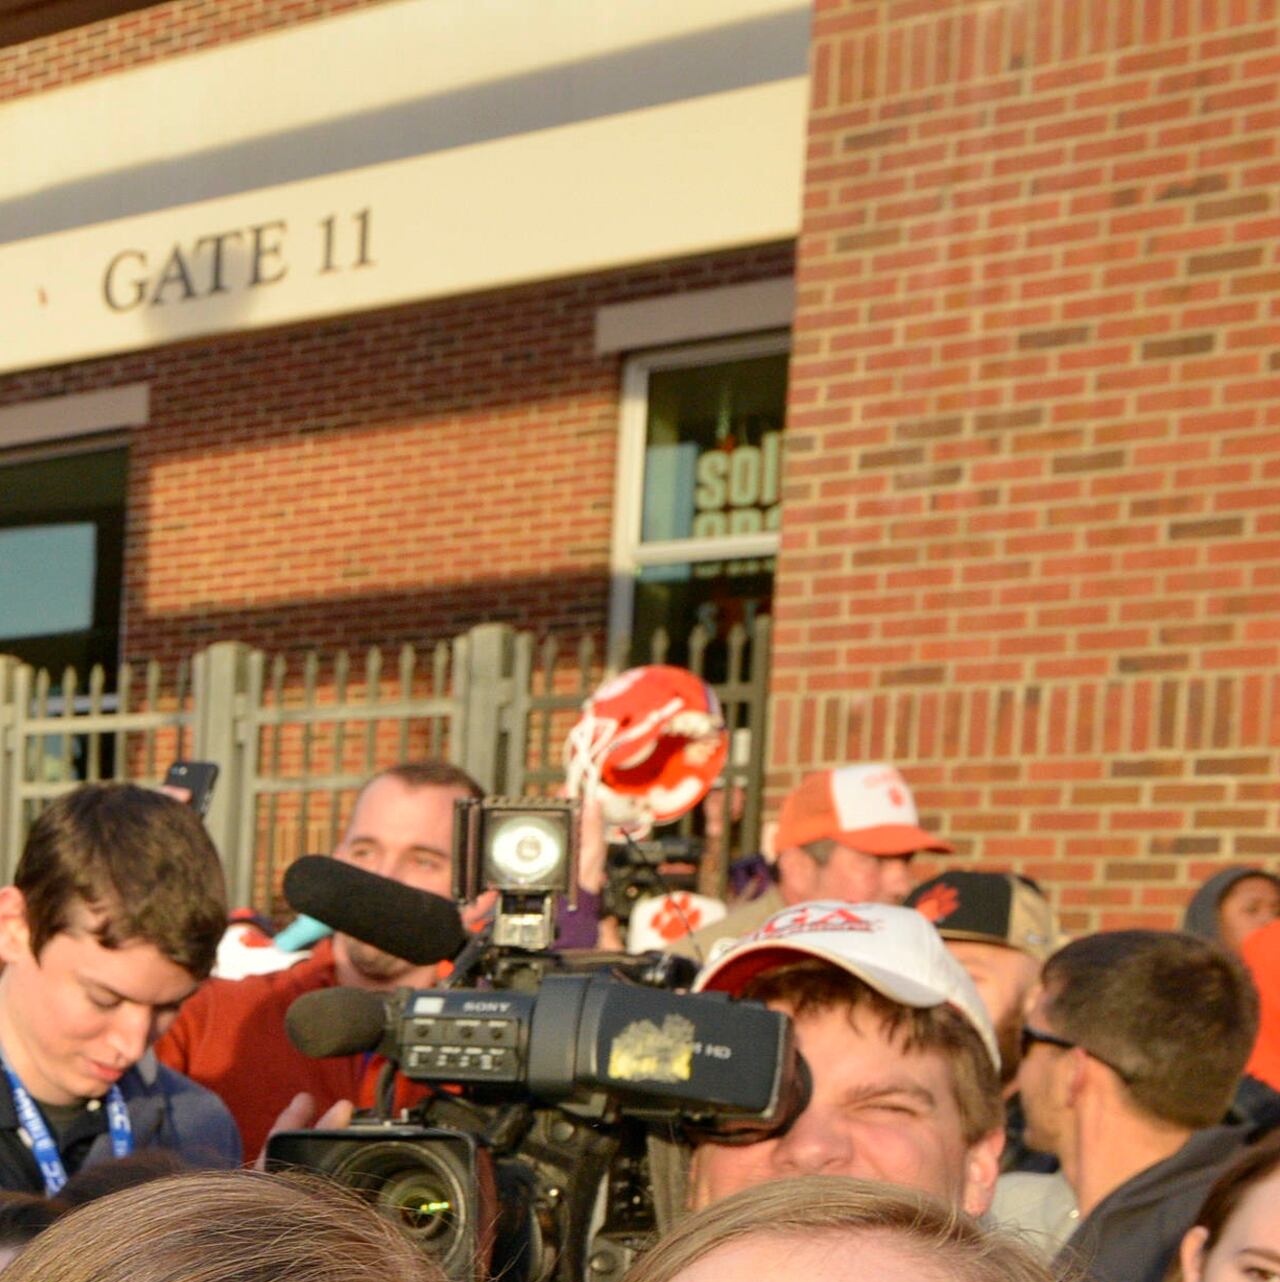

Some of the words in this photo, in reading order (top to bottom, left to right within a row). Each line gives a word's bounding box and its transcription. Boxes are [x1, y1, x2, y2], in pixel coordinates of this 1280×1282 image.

[102, 219, 289, 315] GATE
[318, 206, 376, 276] 11
[695, 431, 780, 510] sol
[462, 1001, 512, 1013] SONY
[705, 1043, 732, 1060] HD
